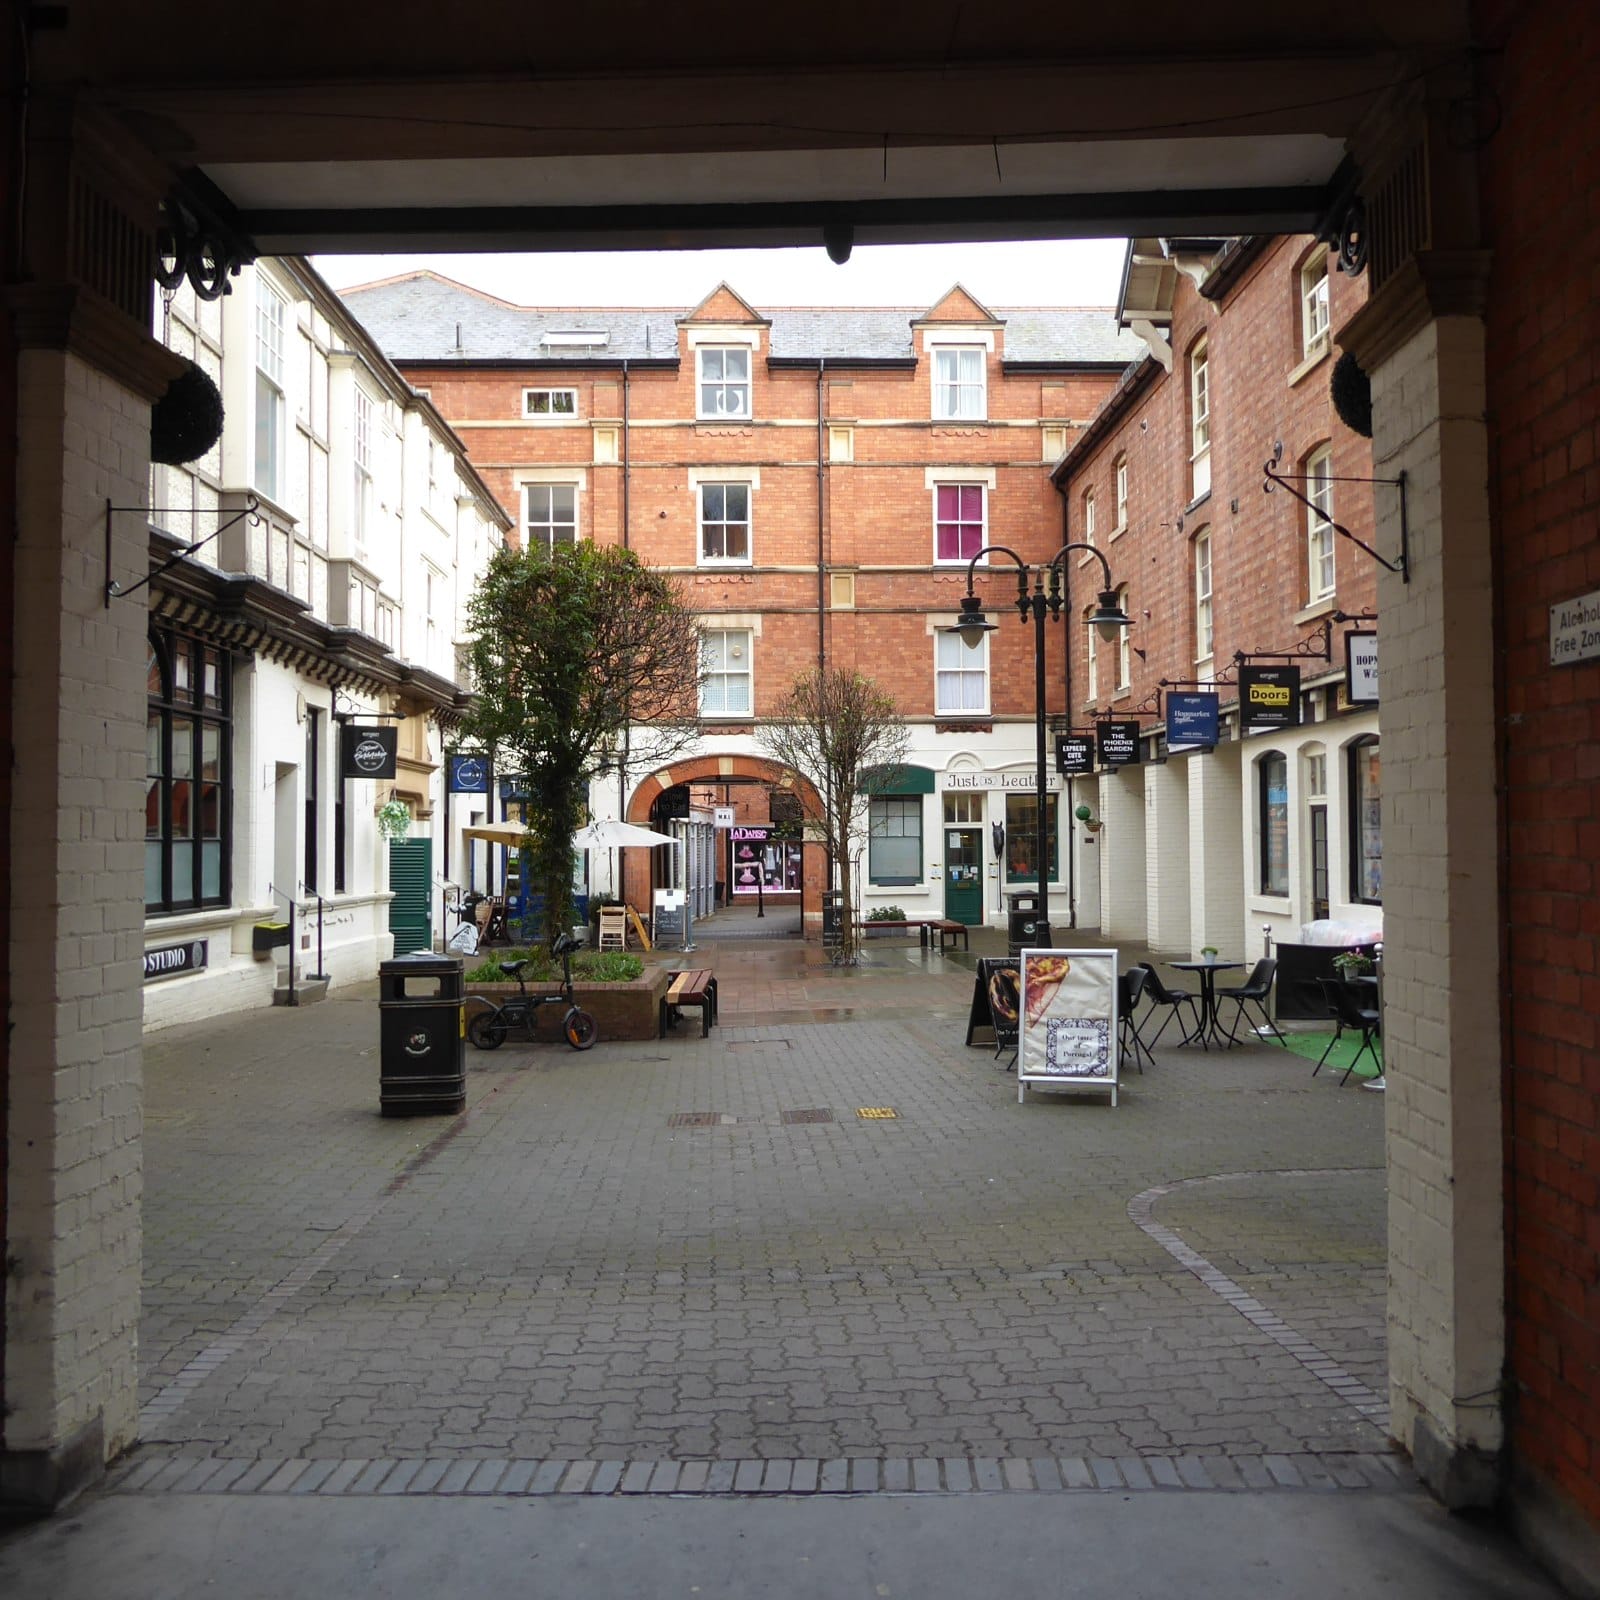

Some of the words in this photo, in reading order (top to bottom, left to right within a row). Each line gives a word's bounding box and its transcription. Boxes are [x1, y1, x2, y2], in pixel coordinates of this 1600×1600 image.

[1560, 602, 1600, 630] Alcohol
[1554, 637, 1577, 656] Free
[1581, 629, 1600, 649] Zon
[1251, 689, 1288, 700] Doors
[948, 774, 978, 787] Just
[1001, 774, 1056, 787] Leatr
[148, 947, 186, 972] STUDIO
[1063, 1050, 1092, 1058] Portugal
